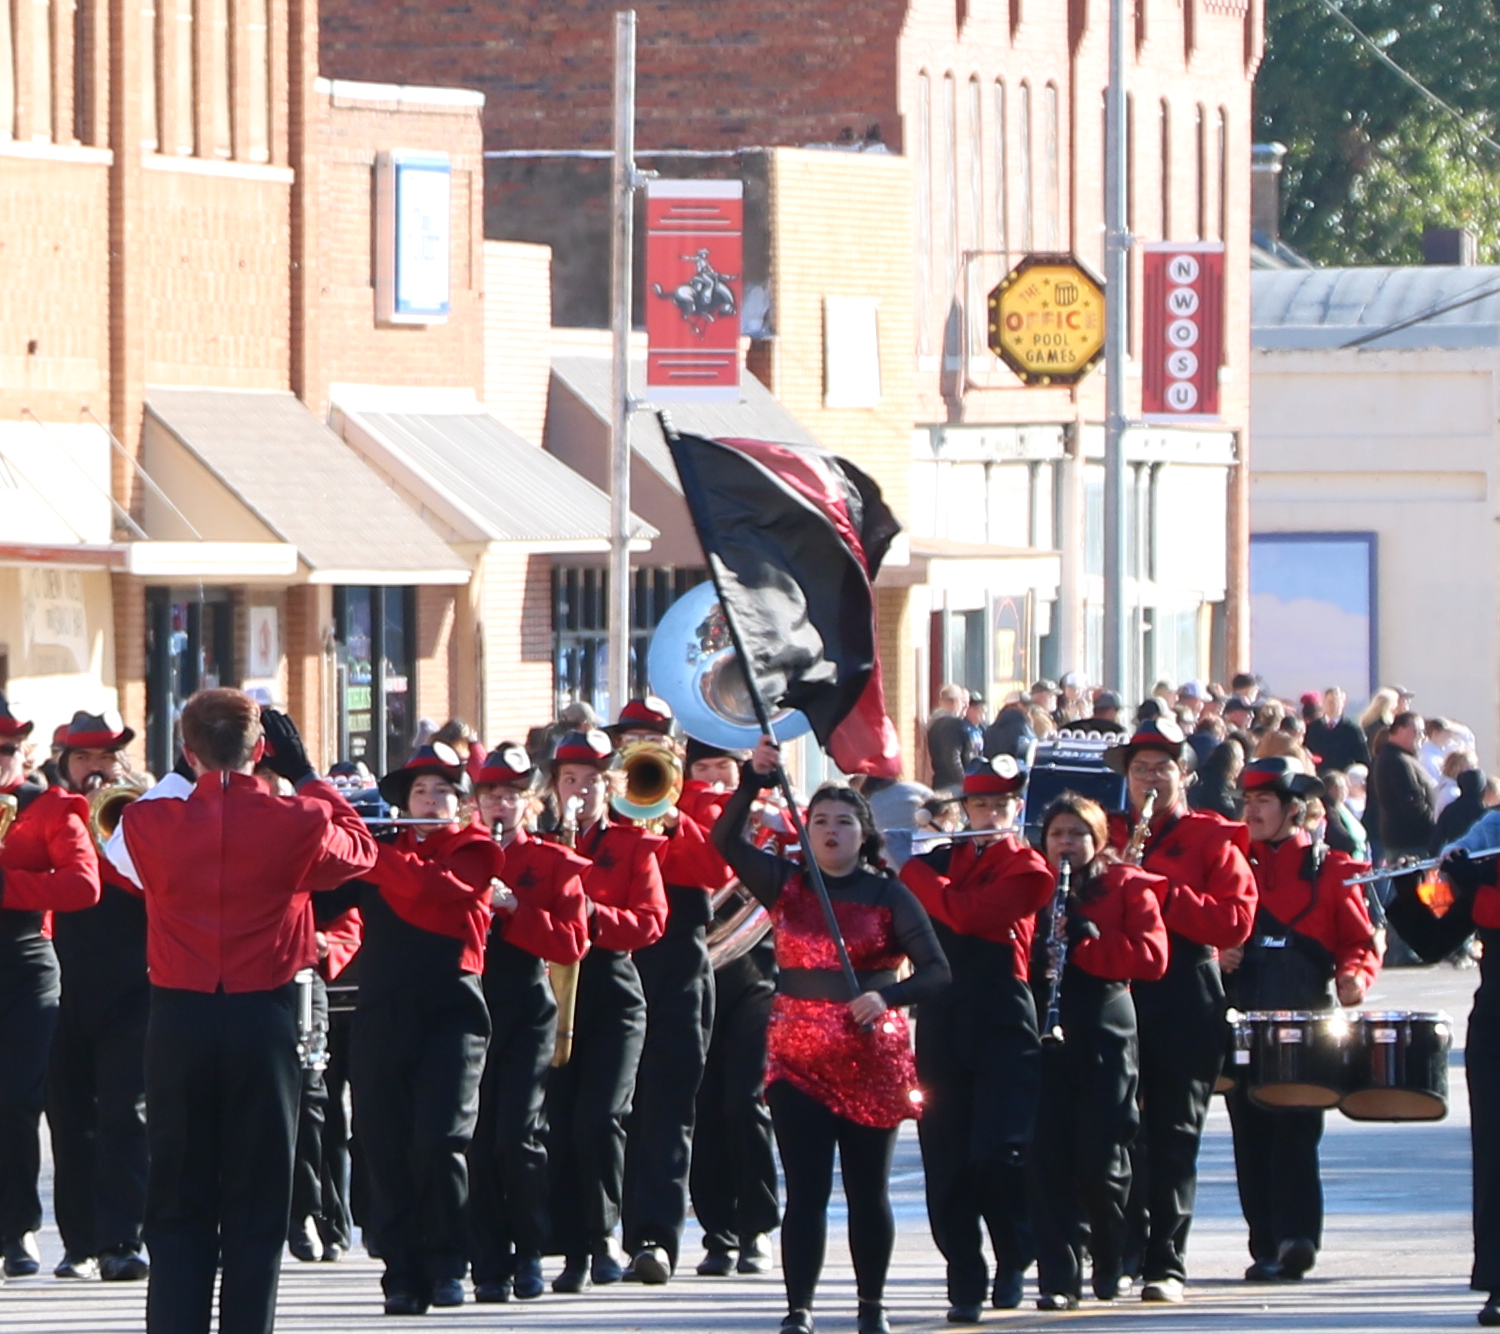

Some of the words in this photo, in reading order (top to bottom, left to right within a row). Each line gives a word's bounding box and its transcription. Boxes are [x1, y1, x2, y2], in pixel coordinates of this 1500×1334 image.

[1018, 283, 1041, 304] THE
[1005, 311, 1099, 332] OFFICE
[1033, 333, 1069, 346] POOL
[1174, 261, 1195, 405] NWOSU
[1025, 349, 1077, 364] GAMES
